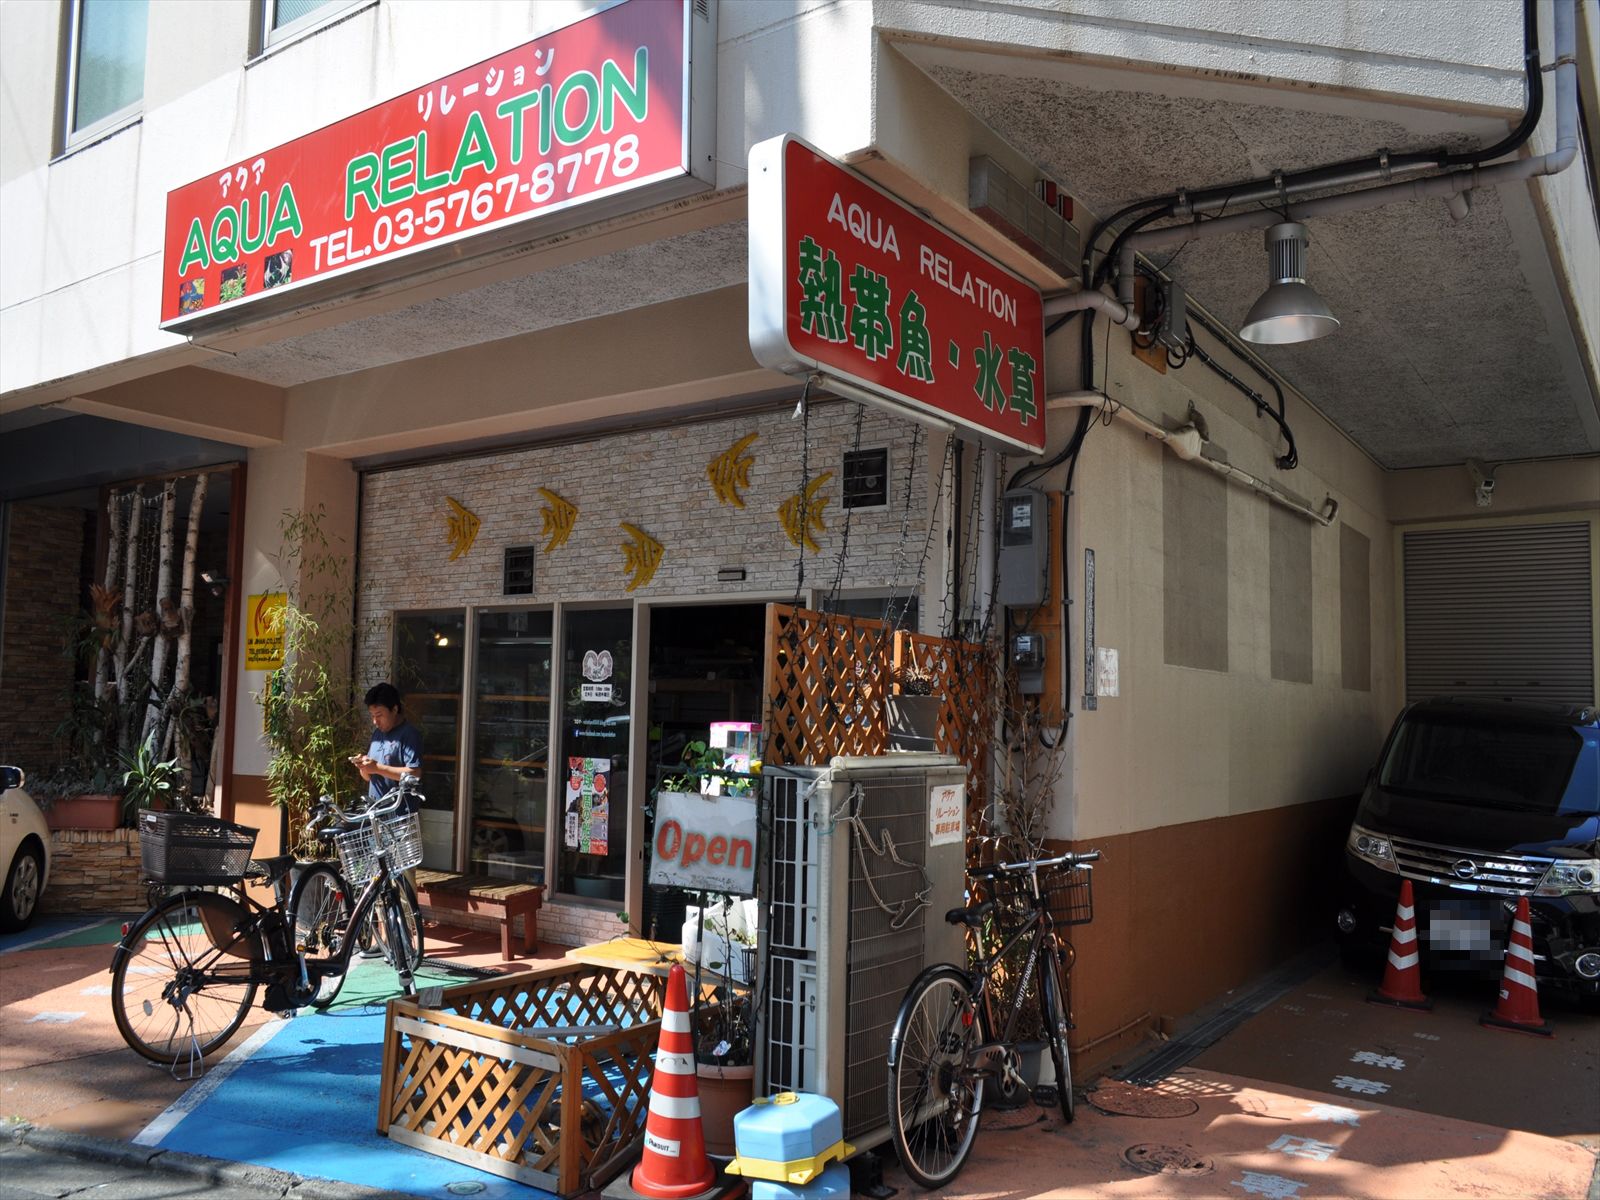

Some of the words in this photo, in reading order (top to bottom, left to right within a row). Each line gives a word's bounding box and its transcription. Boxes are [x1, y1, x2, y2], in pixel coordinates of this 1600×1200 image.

[417, 46, 556, 122] リレーション
[178, 182, 303, 276] AQUA
[344, 45, 649, 220] RELATION
[218, 157, 266, 198] アクア
[309, 134, 640, 272] TEL.03-5767-8778
[827, 192, 900, 261] AQUA
[919, 244, 1017, 327] RELATION
[797, 234, 1038, 426] 熱帯魚・水草
[656, 819, 753, 869] Open
